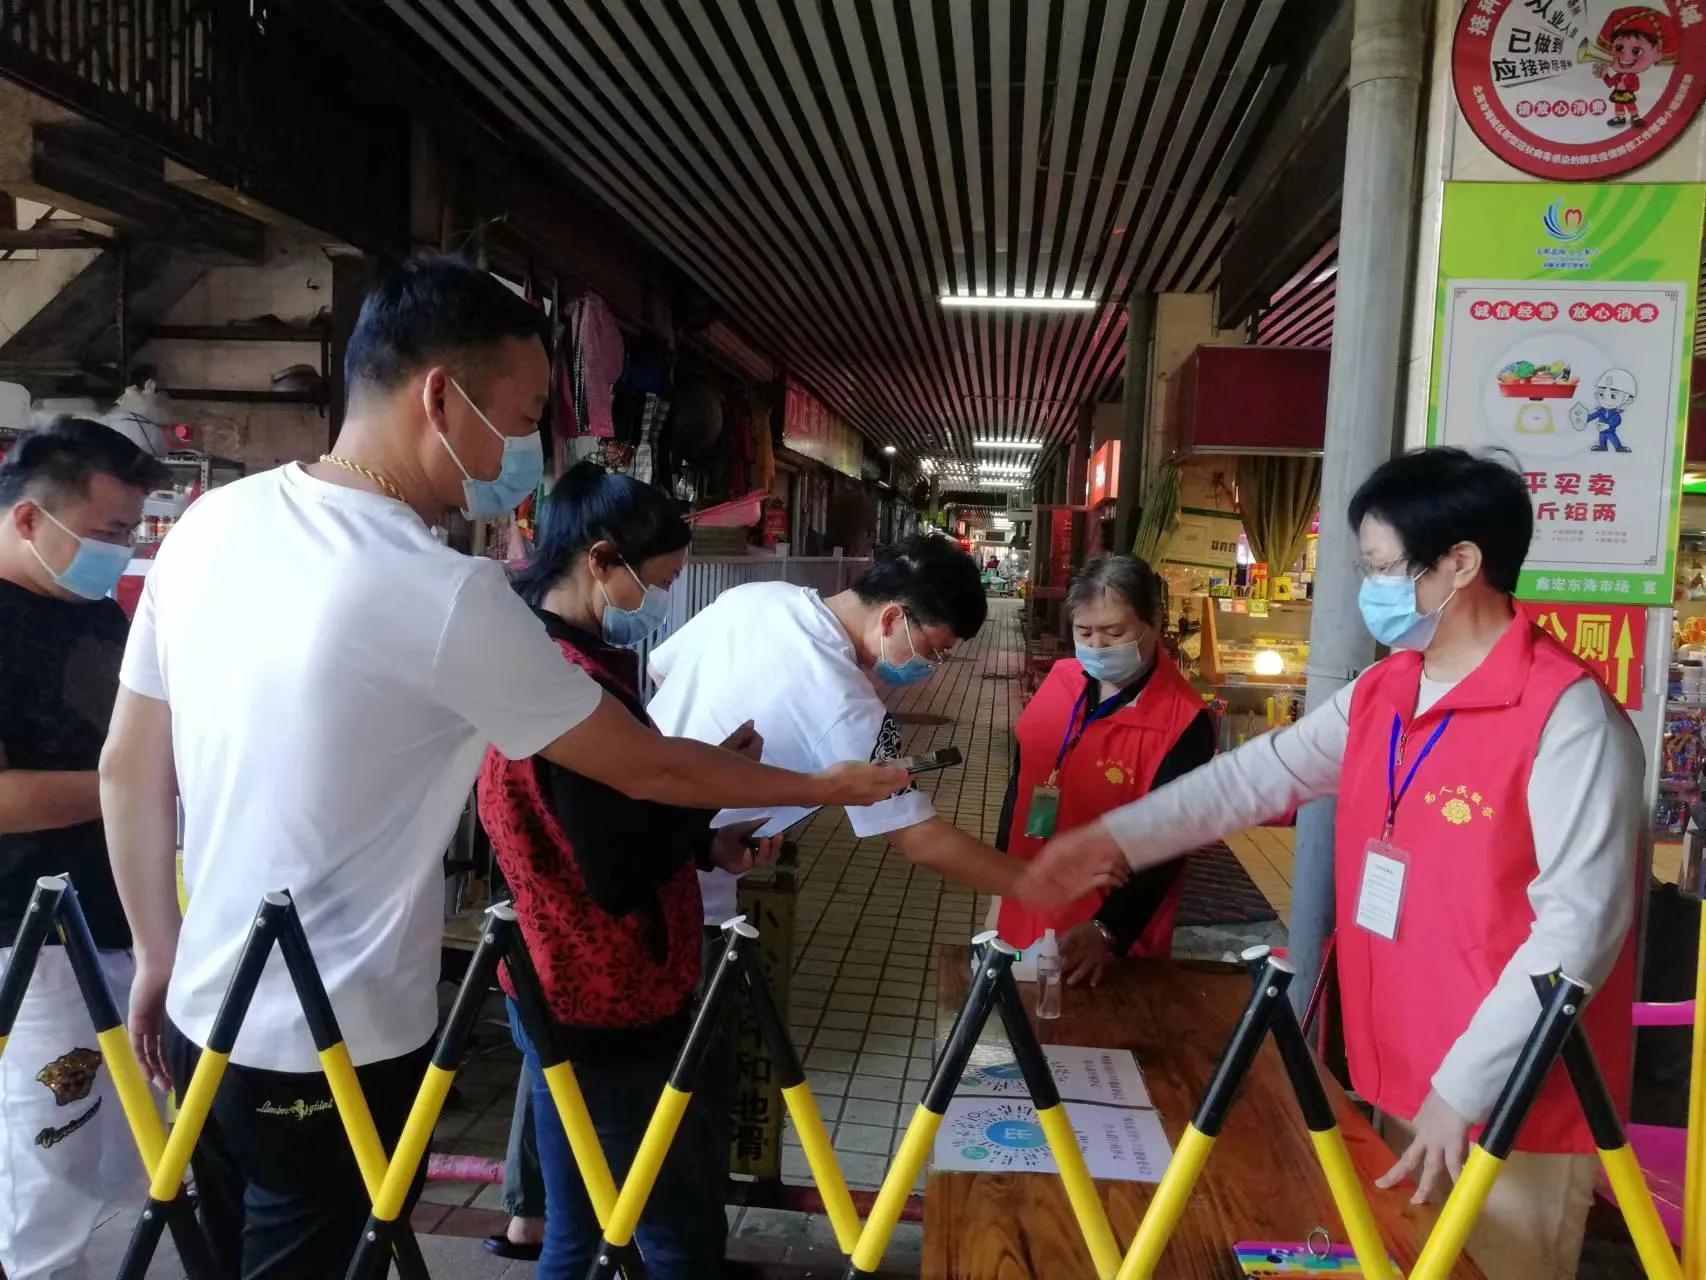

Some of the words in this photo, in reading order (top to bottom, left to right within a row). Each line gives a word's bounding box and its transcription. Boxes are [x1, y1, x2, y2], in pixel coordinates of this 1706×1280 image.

[1508, 28, 1564, 54] 已做到
[1516, 99, 1606, 117] 请放心消费
[1471, 302, 1557, 319] 诚信经营
[1571, 304, 1657, 321] 放心消费
[1537, 501, 1616, 522] 斤短两
